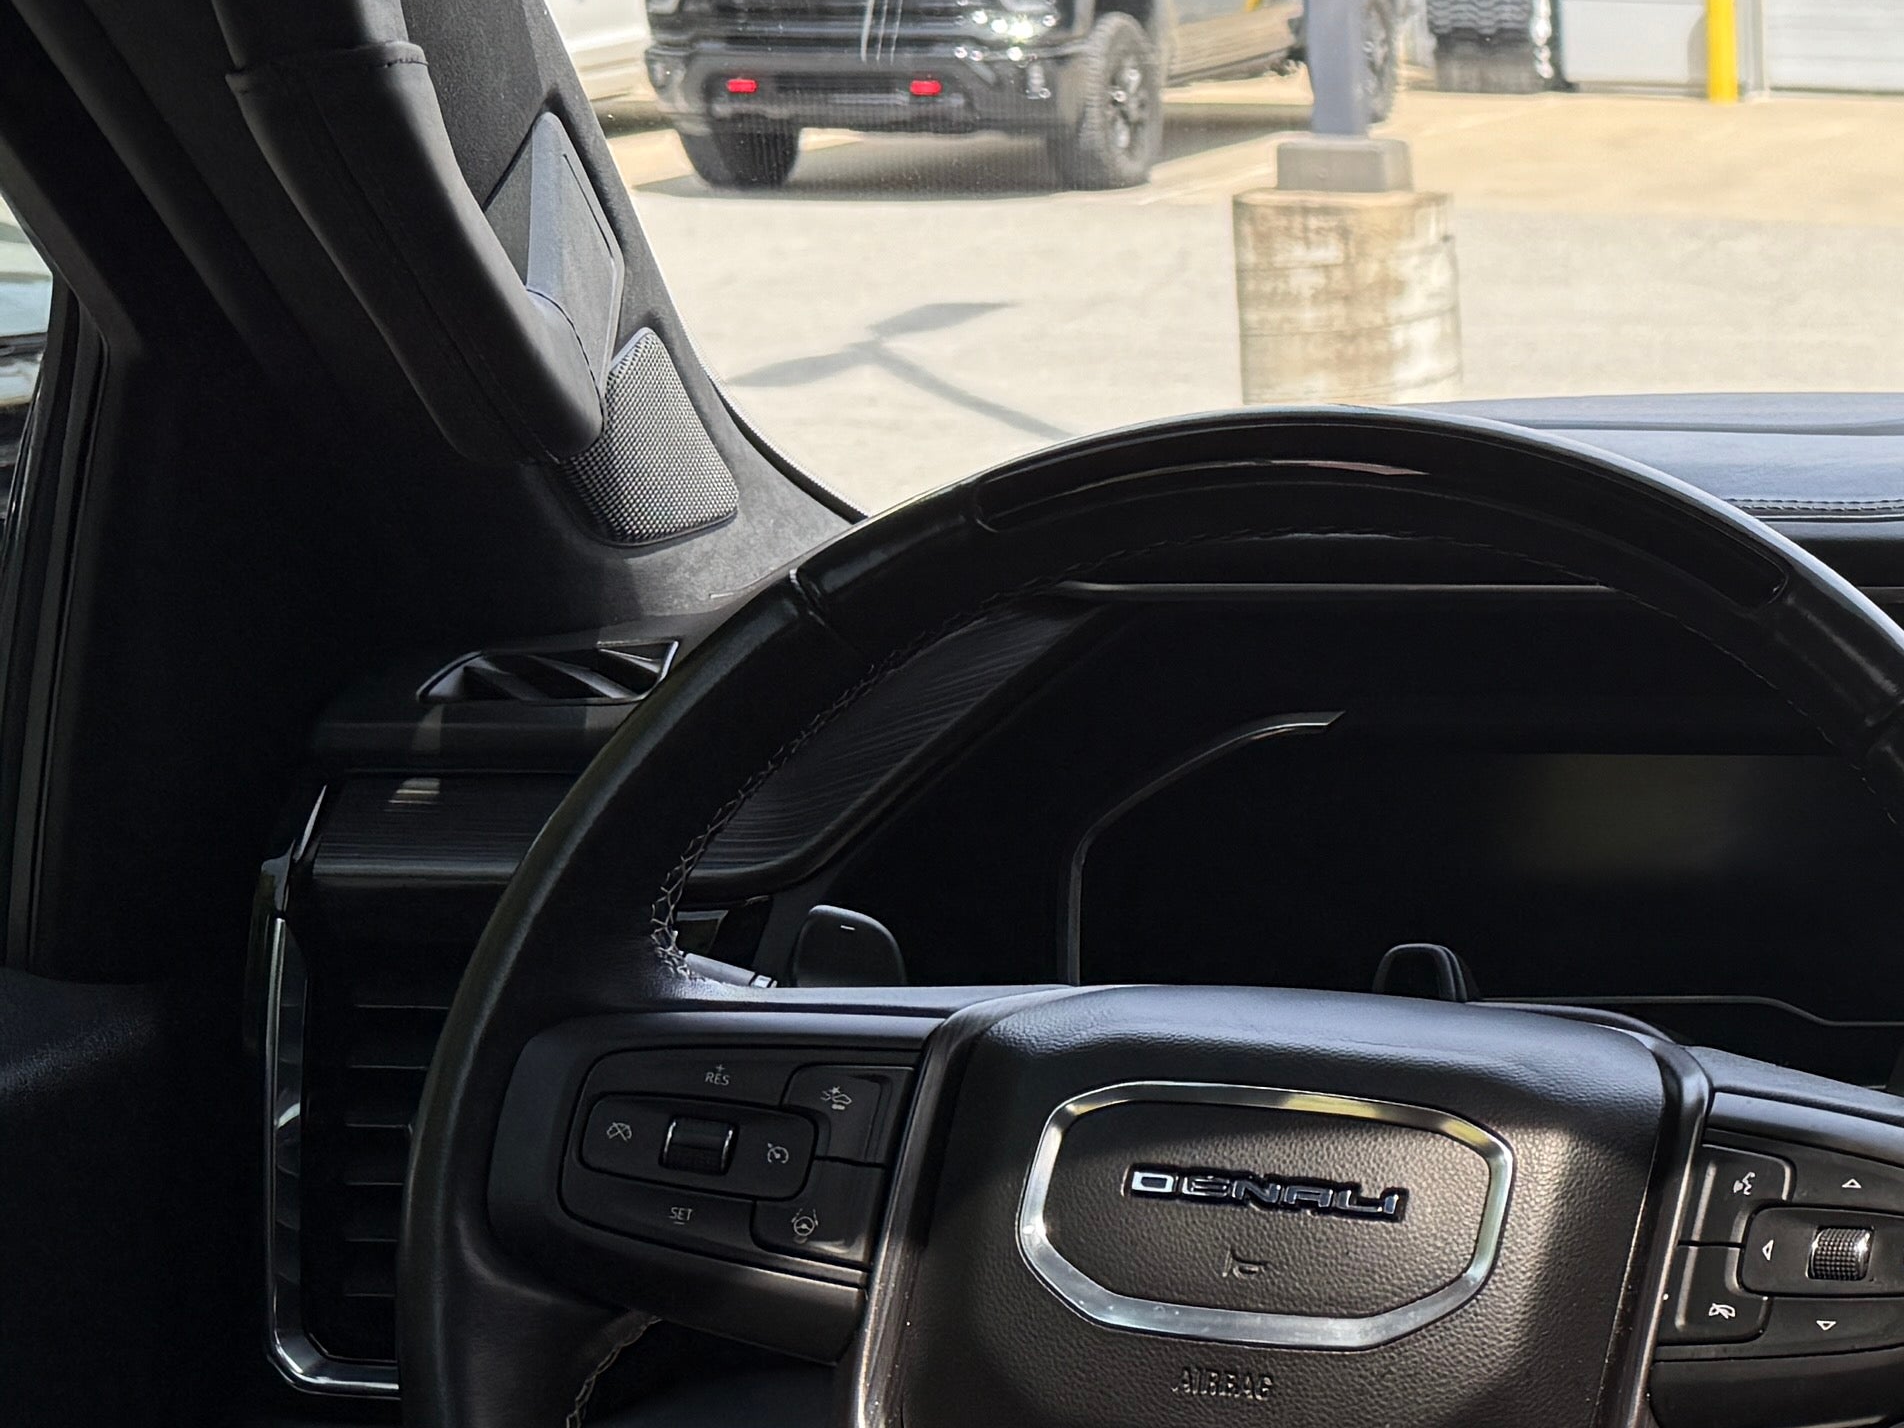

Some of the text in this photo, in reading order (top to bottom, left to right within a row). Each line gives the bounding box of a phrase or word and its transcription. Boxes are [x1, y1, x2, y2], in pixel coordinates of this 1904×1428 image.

[704, 1071, 730, 1087] RES
[1126, 1167, 1403, 1219] DENALI
[669, 1206, 694, 1222] SET
[1170, 1367, 1274, 1401] AIRBAG
